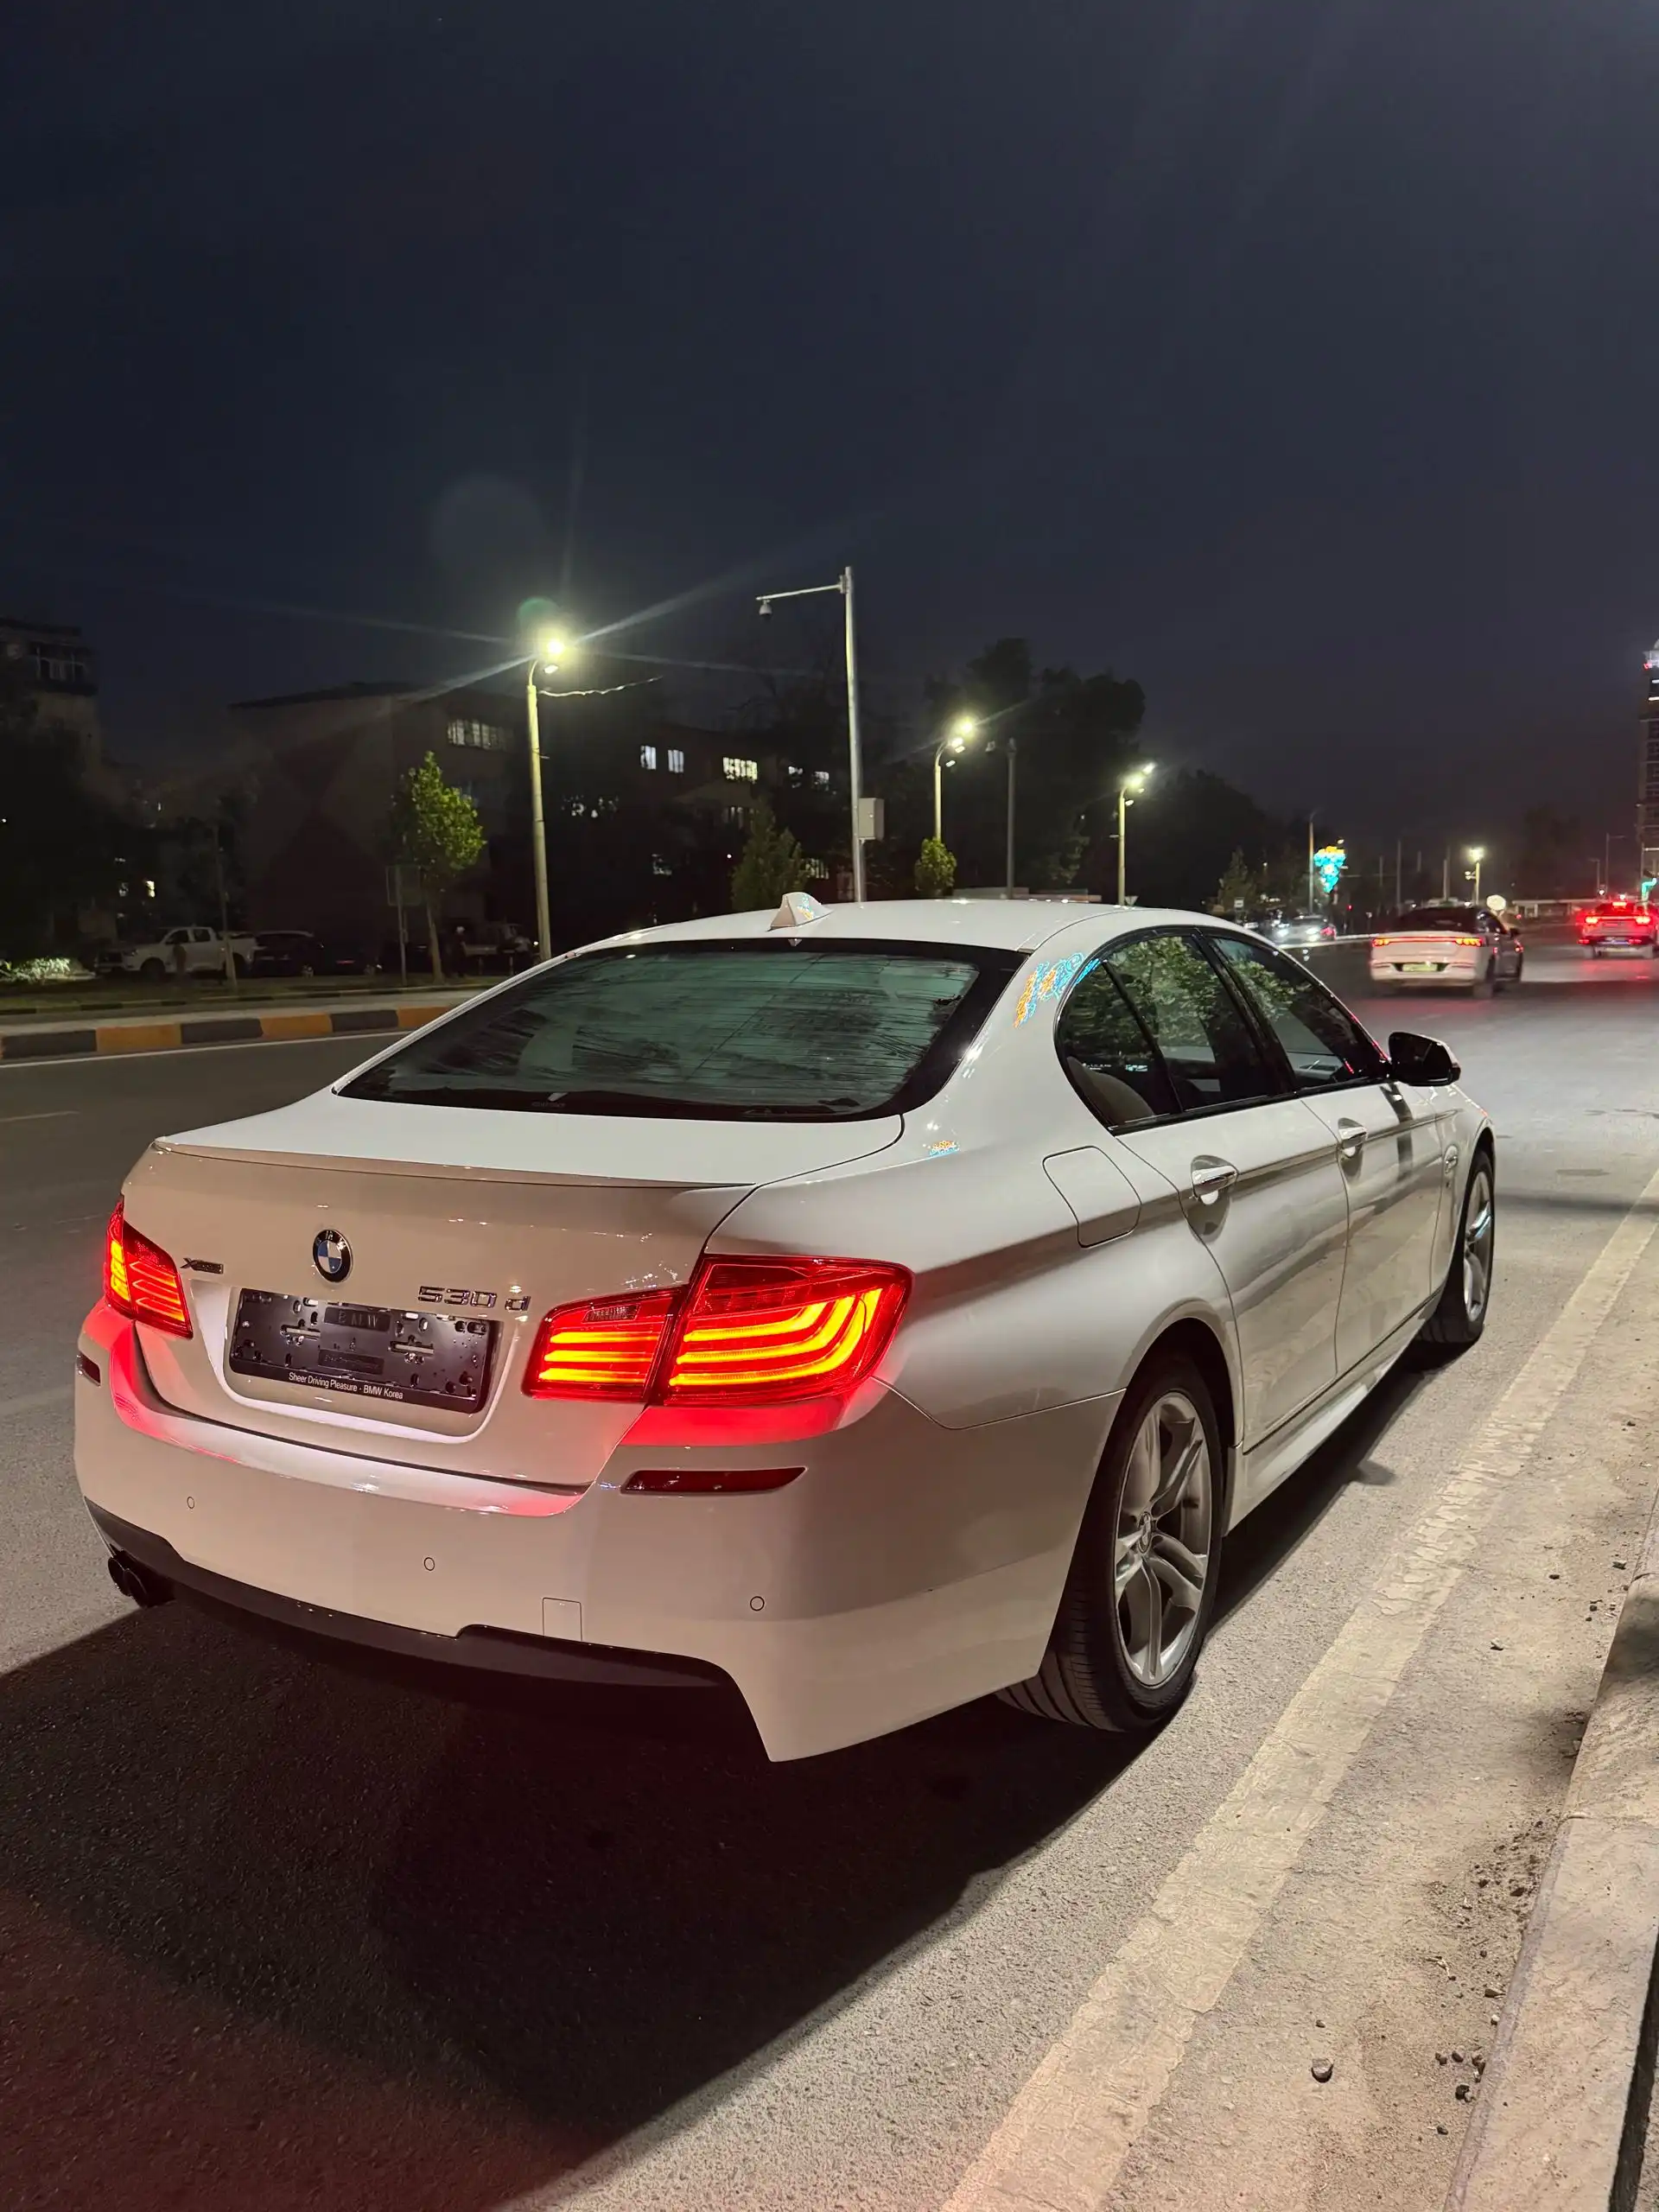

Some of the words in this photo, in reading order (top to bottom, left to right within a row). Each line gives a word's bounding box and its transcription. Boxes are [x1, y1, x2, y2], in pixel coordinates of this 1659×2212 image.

[289, 1372, 307, 1382] Sheer
[308, 1376, 329, 1389] Driving
[330, 1379, 358, 1392] Pleasure
[363, 1384, 382, 1395] BMW
[384, 1388, 404, 1399] Korea
